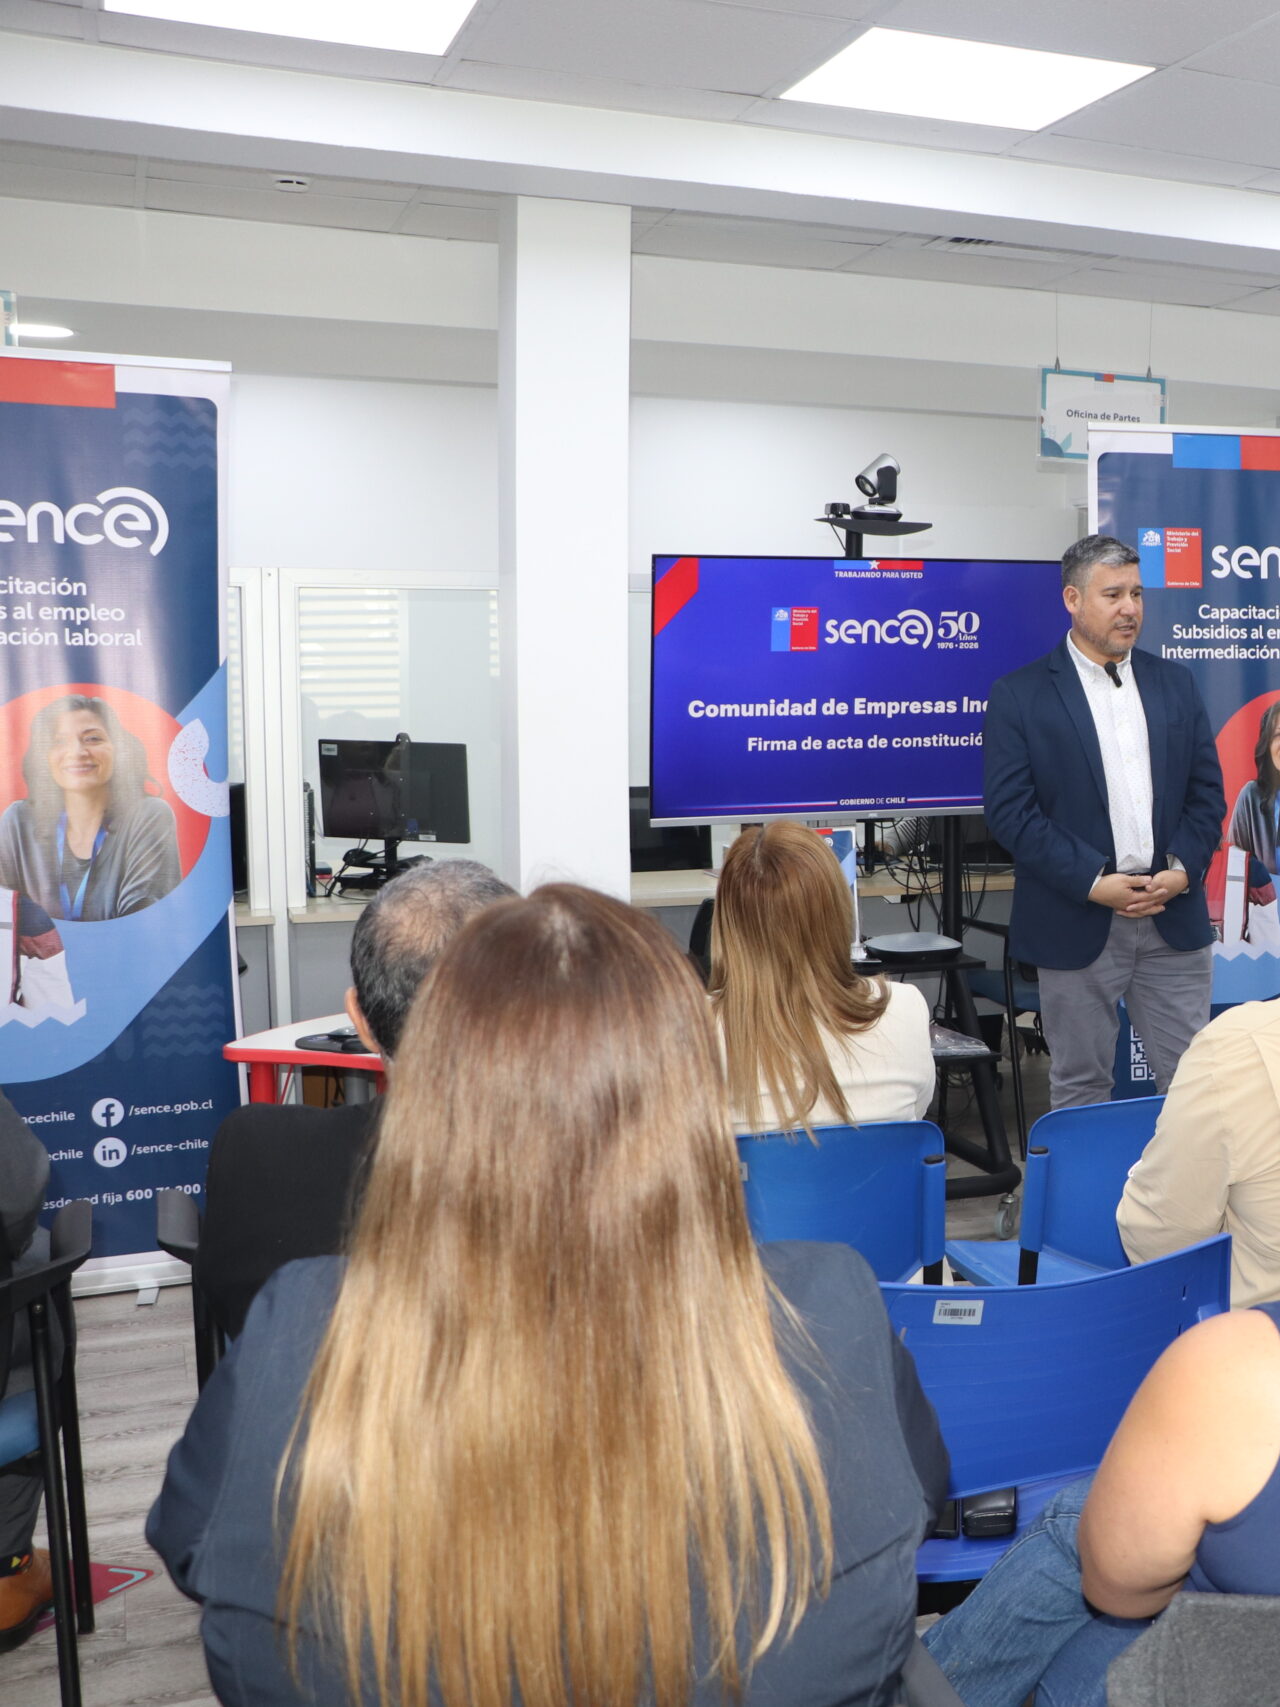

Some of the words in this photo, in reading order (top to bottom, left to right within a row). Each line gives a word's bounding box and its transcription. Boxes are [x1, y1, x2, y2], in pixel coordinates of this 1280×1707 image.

[1066, 409, 1098, 420] Oficina
[1100, 412, 1111, 421] de
[1113, 413, 1141, 423] Partes
[835, 571, 881, 579] TRABAJANDO
[882, 571, 900, 579] PARA
[12, 602, 34, 620] al
[38, 603, 125, 626] empleo
[65, 628, 143, 647] laboral
[825, 609, 934, 650] sence
[937, 611, 981, 639] 50
[1172, 624, 1248, 640] Subsidios
[1250, 625, 1263, 640] al
[1161, 644, 1280, 659] Intermediación
[688, 699, 817, 718] Comunidad
[821, 698, 849, 715] de
[854, 697, 957, 718] Empresas
[748, 737, 797, 752] Firma
[801, 736, 823, 750] de
[826, 737, 864, 750] acta
[867, 735, 888, 748] de
[839, 798, 875, 806] GOBIERNO
[128, 1099, 214, 1117] /sence.gob.cl
[131, 1139, 209, 1156] /sence-chile
[102, 1193, 123, 1206] fija
[126, 1188, 153, 1202] 600
